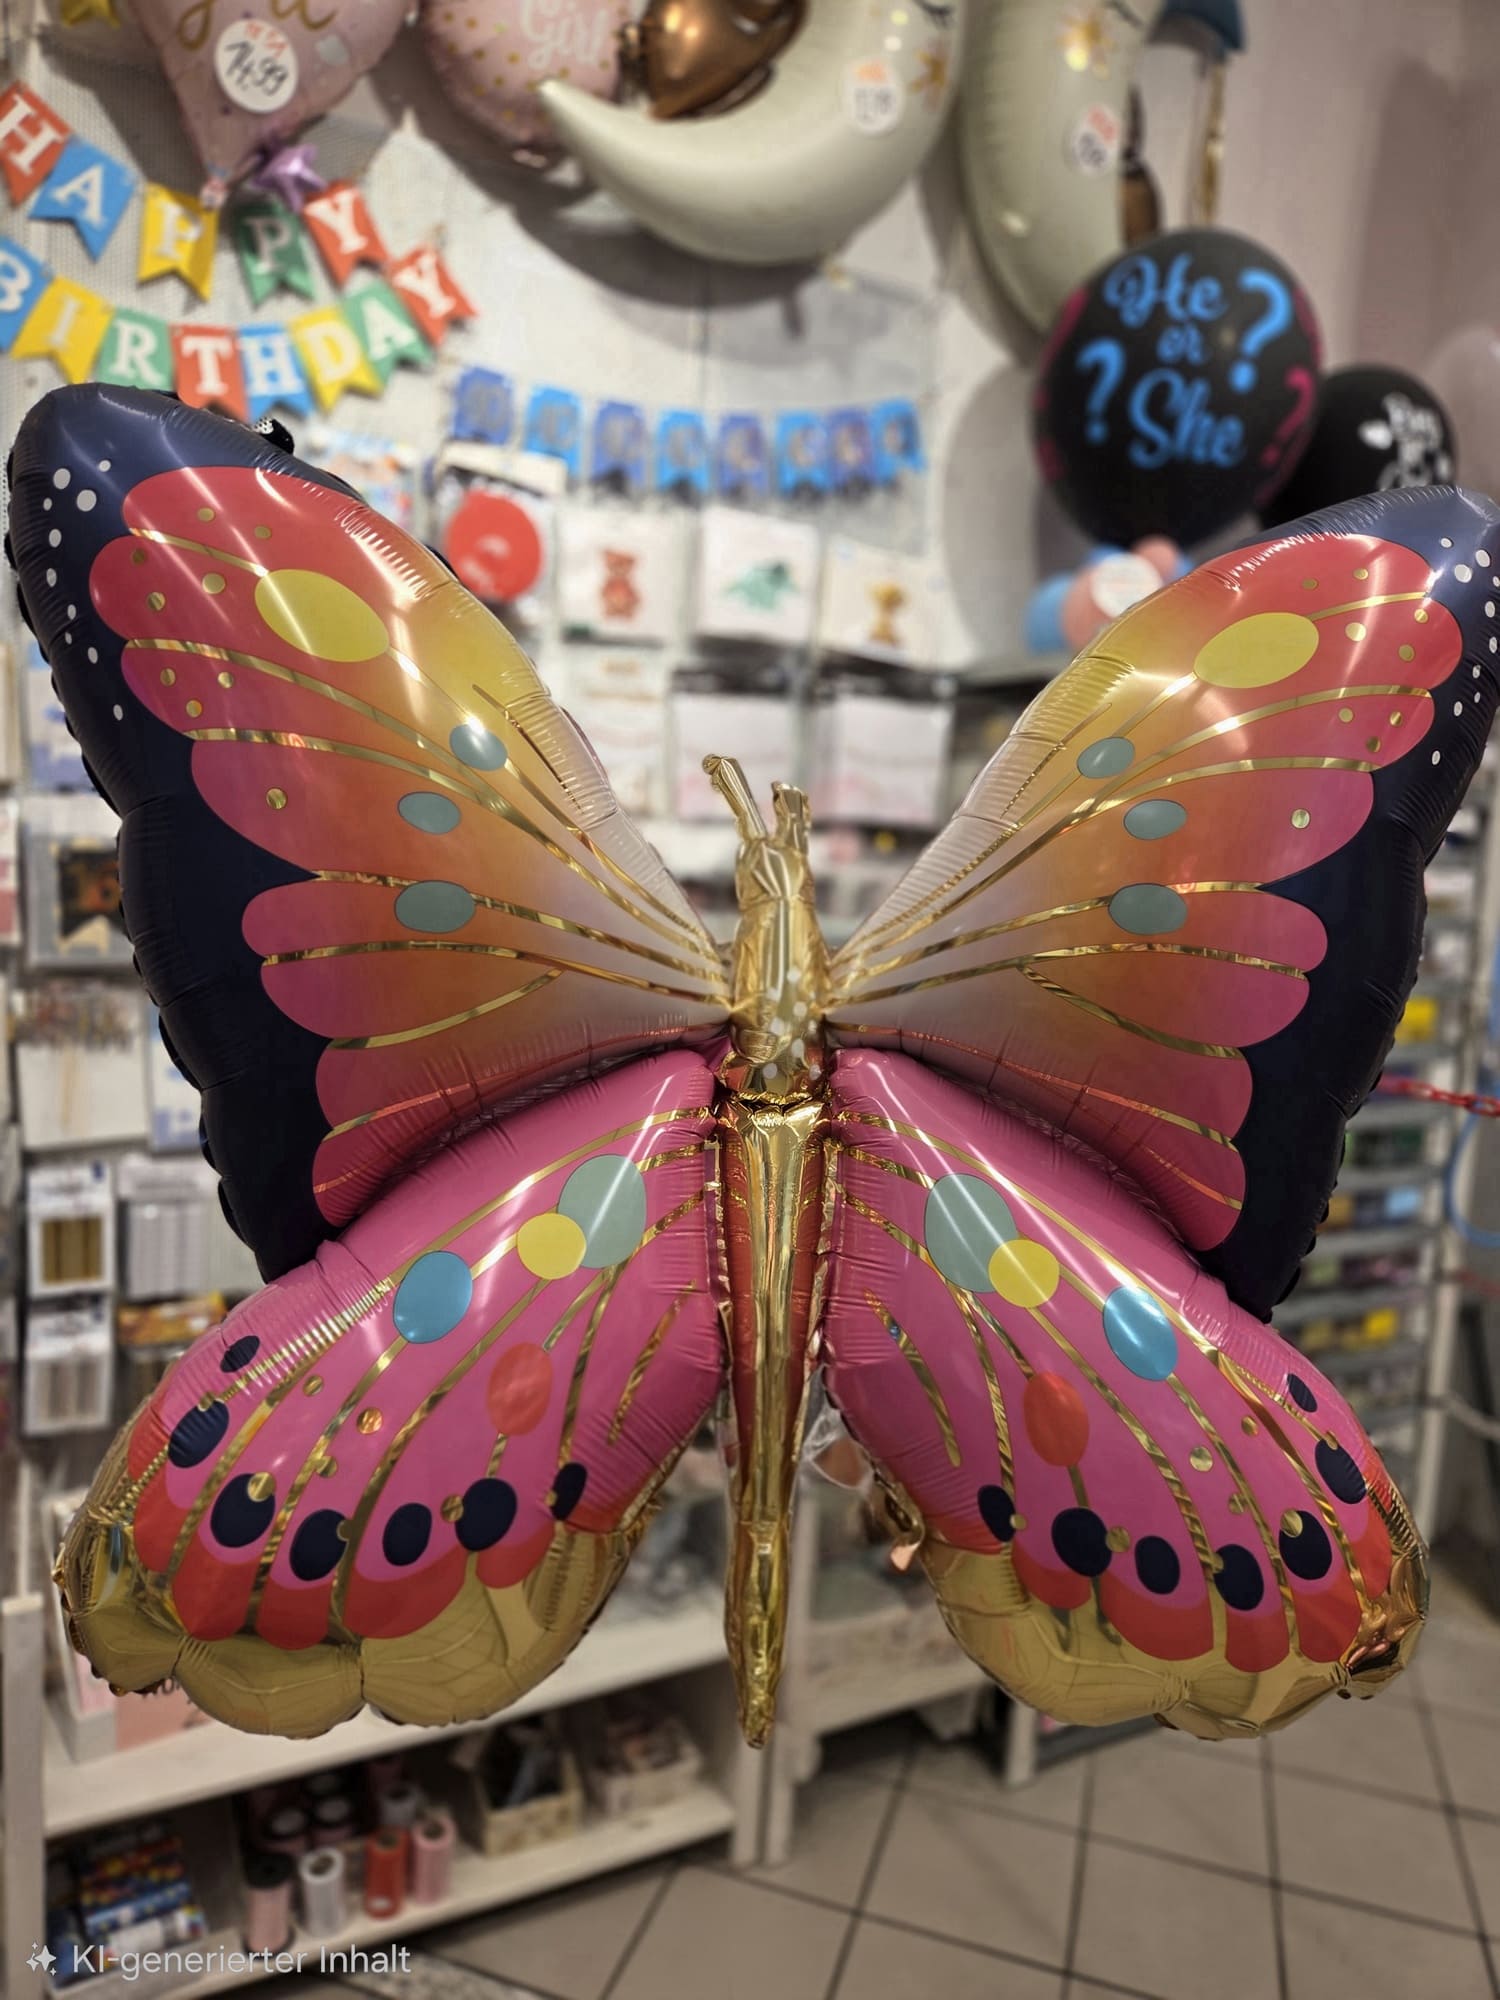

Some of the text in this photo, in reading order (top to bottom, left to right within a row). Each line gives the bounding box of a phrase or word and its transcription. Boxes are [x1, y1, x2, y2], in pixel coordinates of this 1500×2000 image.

[0, 93, 369, 274] HAPPY
[0, 248, 457, 395] BIRTHDAY
[1104, 253, 1228, 327] He
[1128, 367, 1247, 469] She
